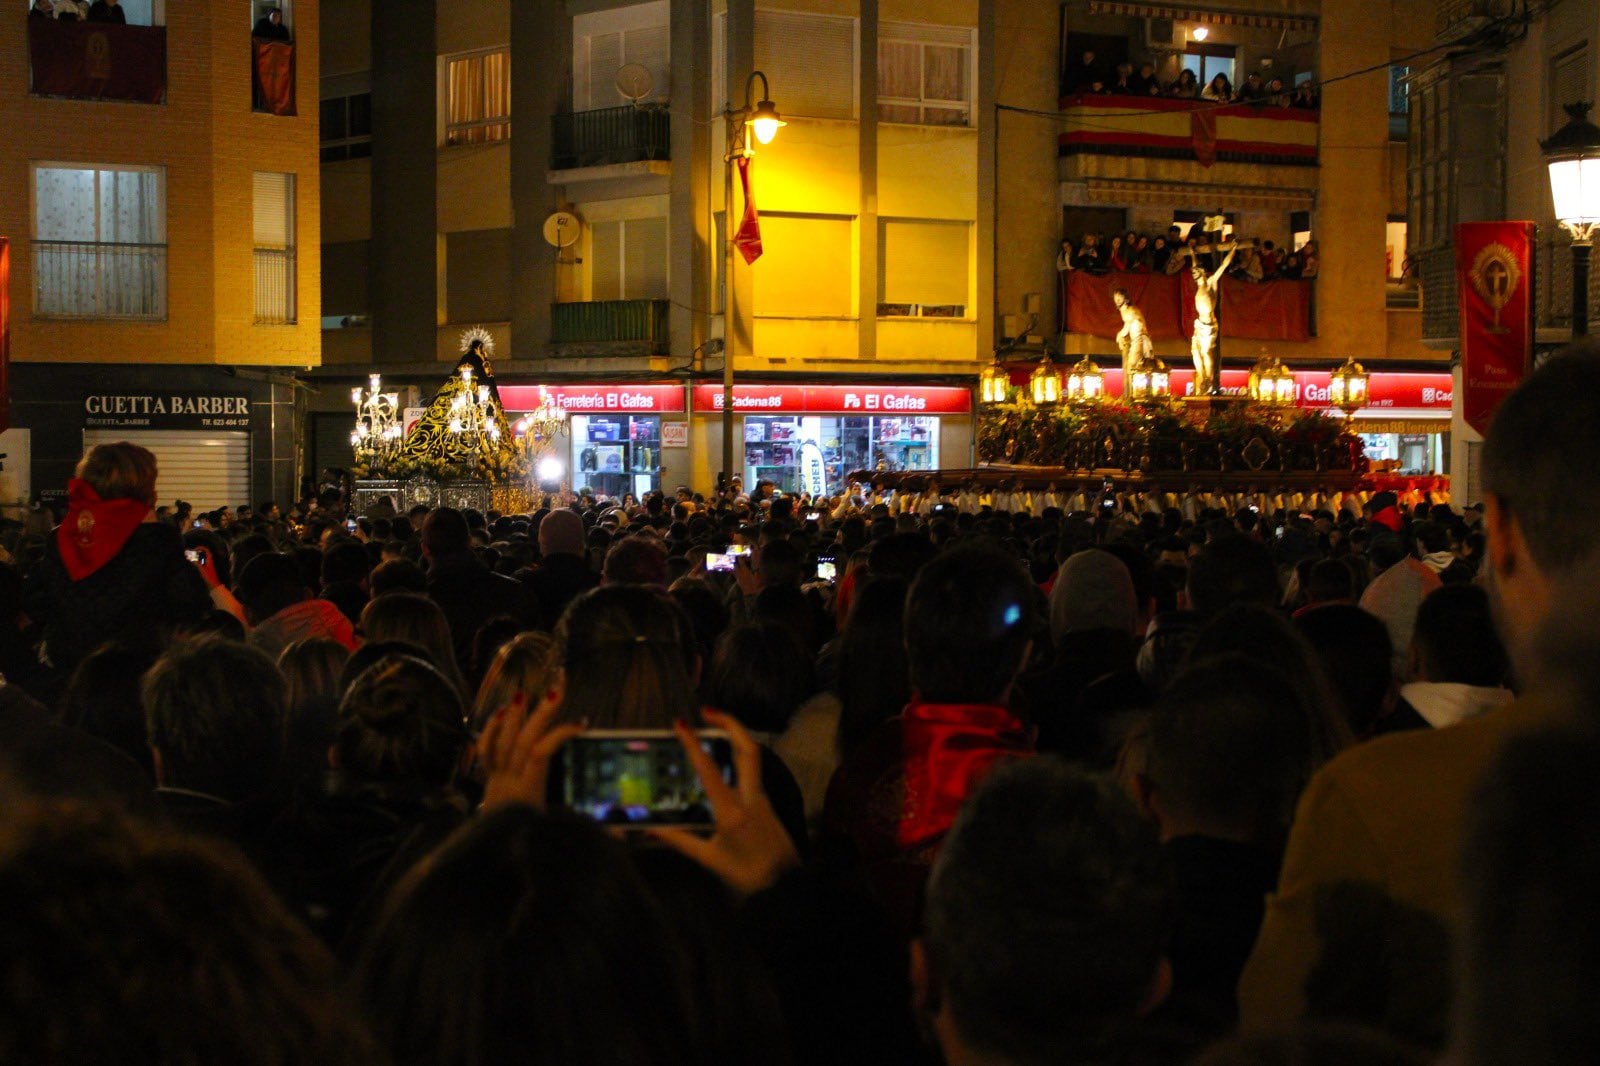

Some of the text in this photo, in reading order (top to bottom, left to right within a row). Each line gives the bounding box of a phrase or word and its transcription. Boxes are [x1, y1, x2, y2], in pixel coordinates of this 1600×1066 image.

[85, 396, 249, 415] GUETTA BARBER
[557, 393, 604, 408] Ferretería
[607, 394, 618, 408] El
[619, 393, 655, 409] Gafas
[864, 394, 880, 409] El
[883, 394, 927, 410] Gafas
